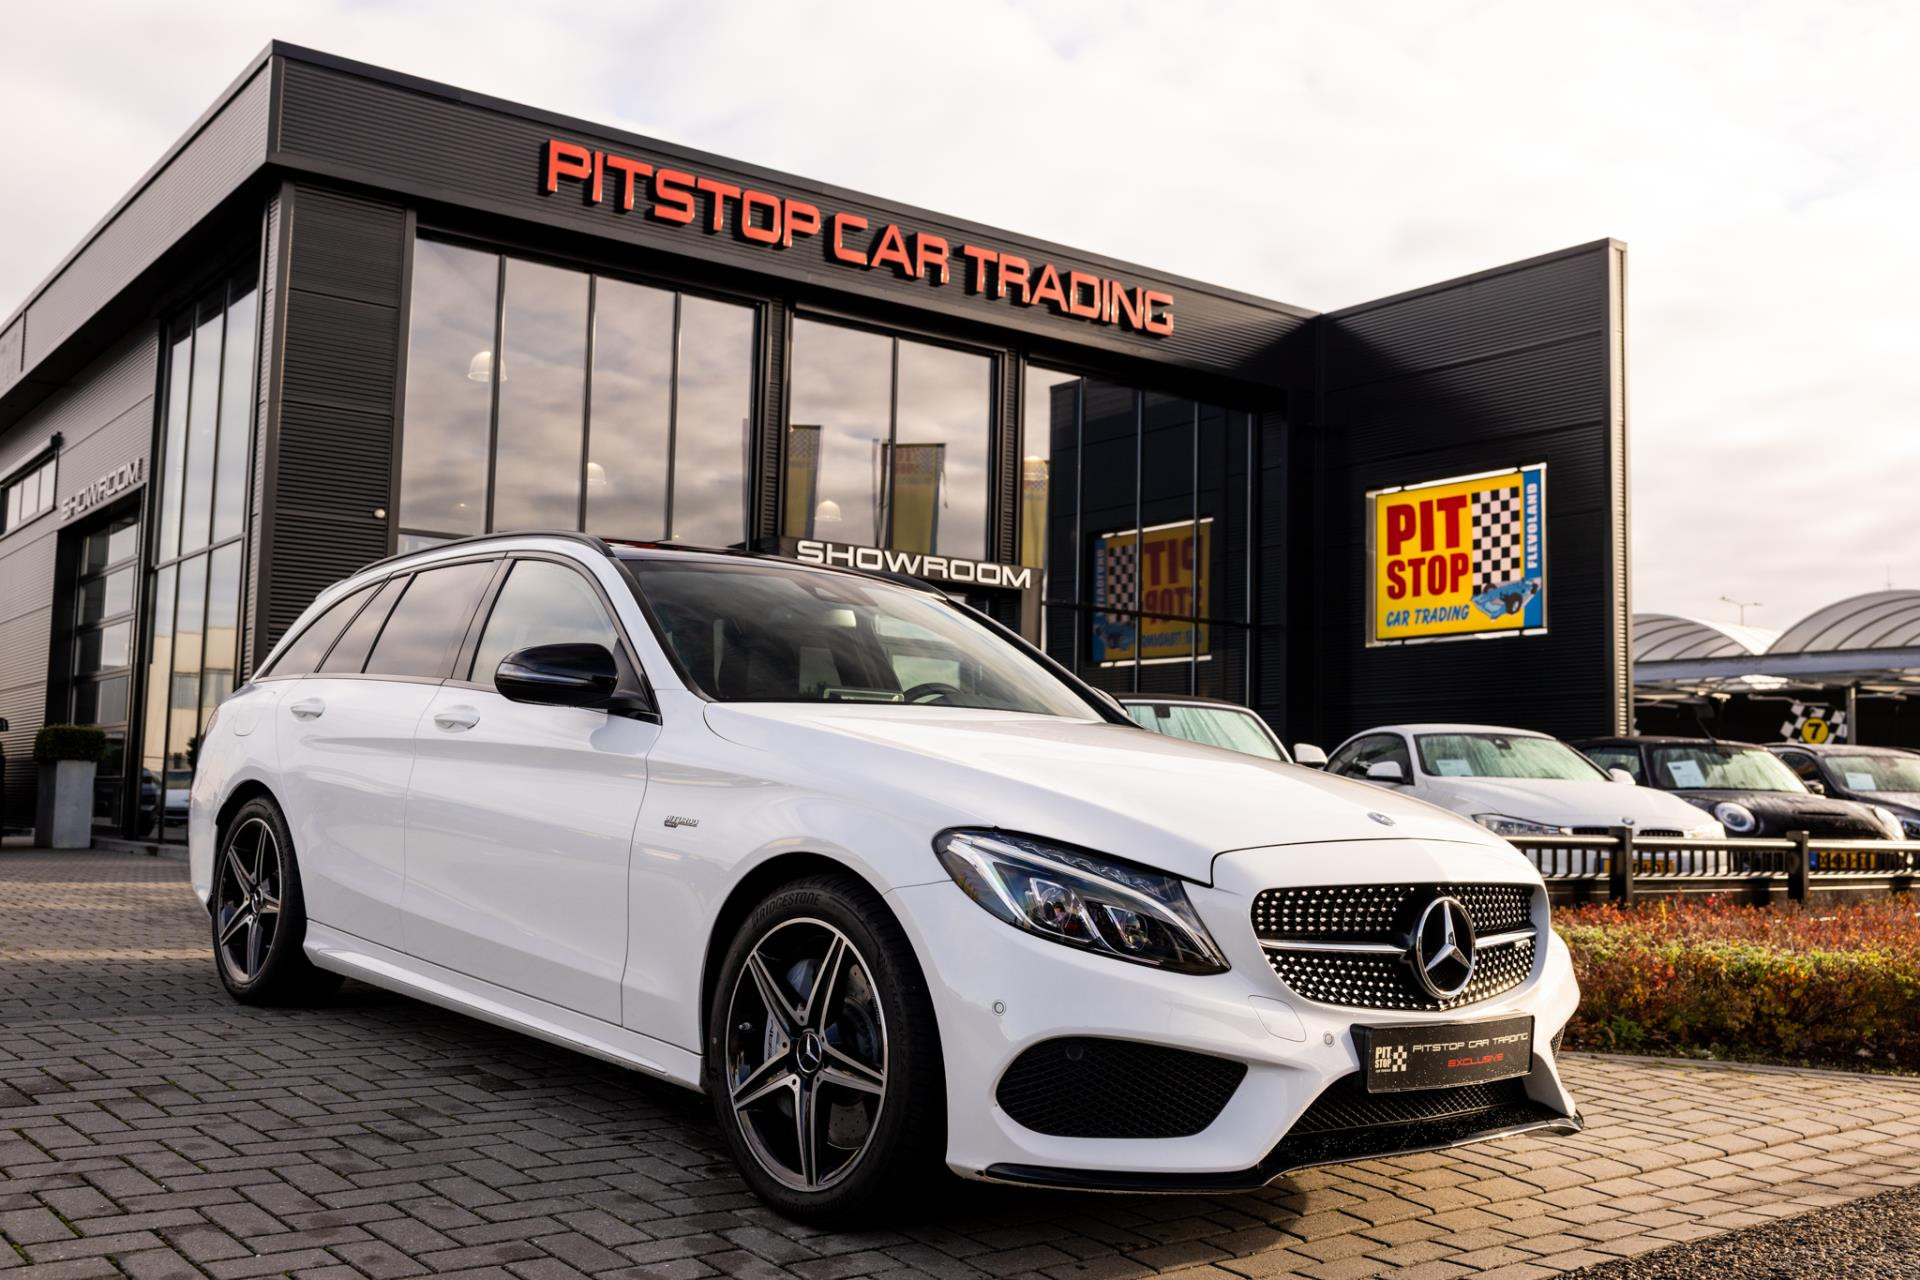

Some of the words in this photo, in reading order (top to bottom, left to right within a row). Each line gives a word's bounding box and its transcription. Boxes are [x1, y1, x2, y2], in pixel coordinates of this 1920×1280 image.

[546, 139, 821, 248] PITSTOP
[833, 213, 949, 284] CAR
[964, 245, 1174, 337] TRADING
[61, 457, 143, 520] SHOWROOM
[1386, 494, 1467, 556] PIT
[1527, 483, 1538, 569] FLEVOLAND
[797, 540, 1031, 589] SHOWROOM
[1386, 553, 1469, 600] STOP
[1386, 610, 1410, 627] CAR
[1414, 604, 1470, 625] TRADING
[1808, 723, 1822, 740] 7
[1375, 1046, 1392, 1059] PIT
[1375, 1059, 1391, 1068] STOP
[1412, 1041, 1465, 1054] PITSTOP
[1468, 1039, 1489, 1049] CAR
